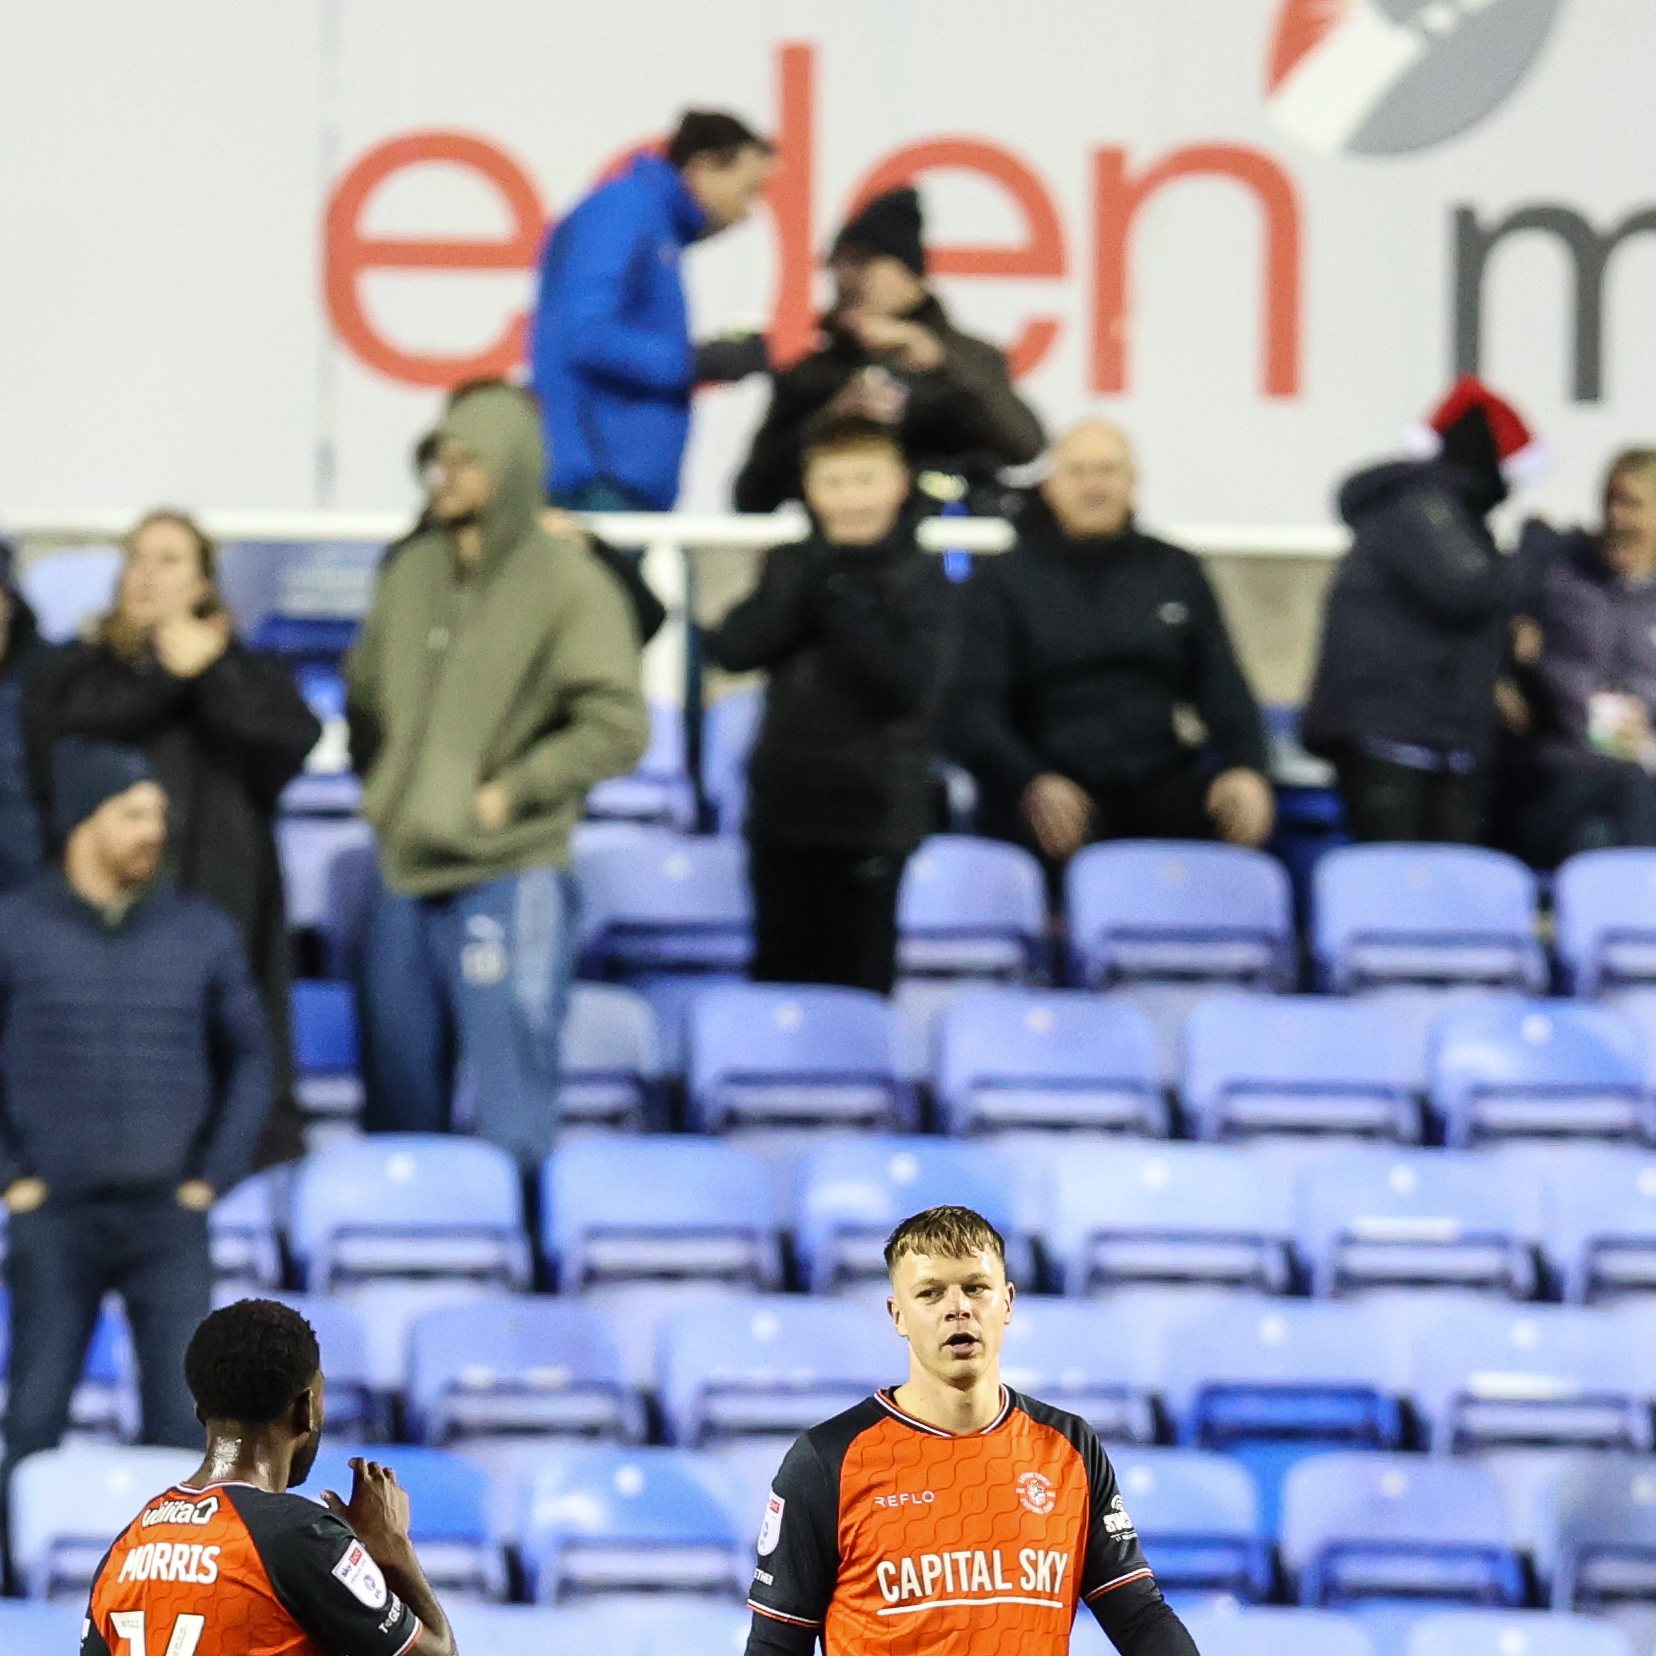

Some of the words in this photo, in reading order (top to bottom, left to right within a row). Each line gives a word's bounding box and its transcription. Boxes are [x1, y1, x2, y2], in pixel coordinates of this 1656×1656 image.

[875, 1490, 935, 1507] REFLO
[117, 1542, 222, 1585] MORRIS
[876, 1549, 1013, 1603] CAPITAL
[1018, 1547, 1069, 1594] SKY
